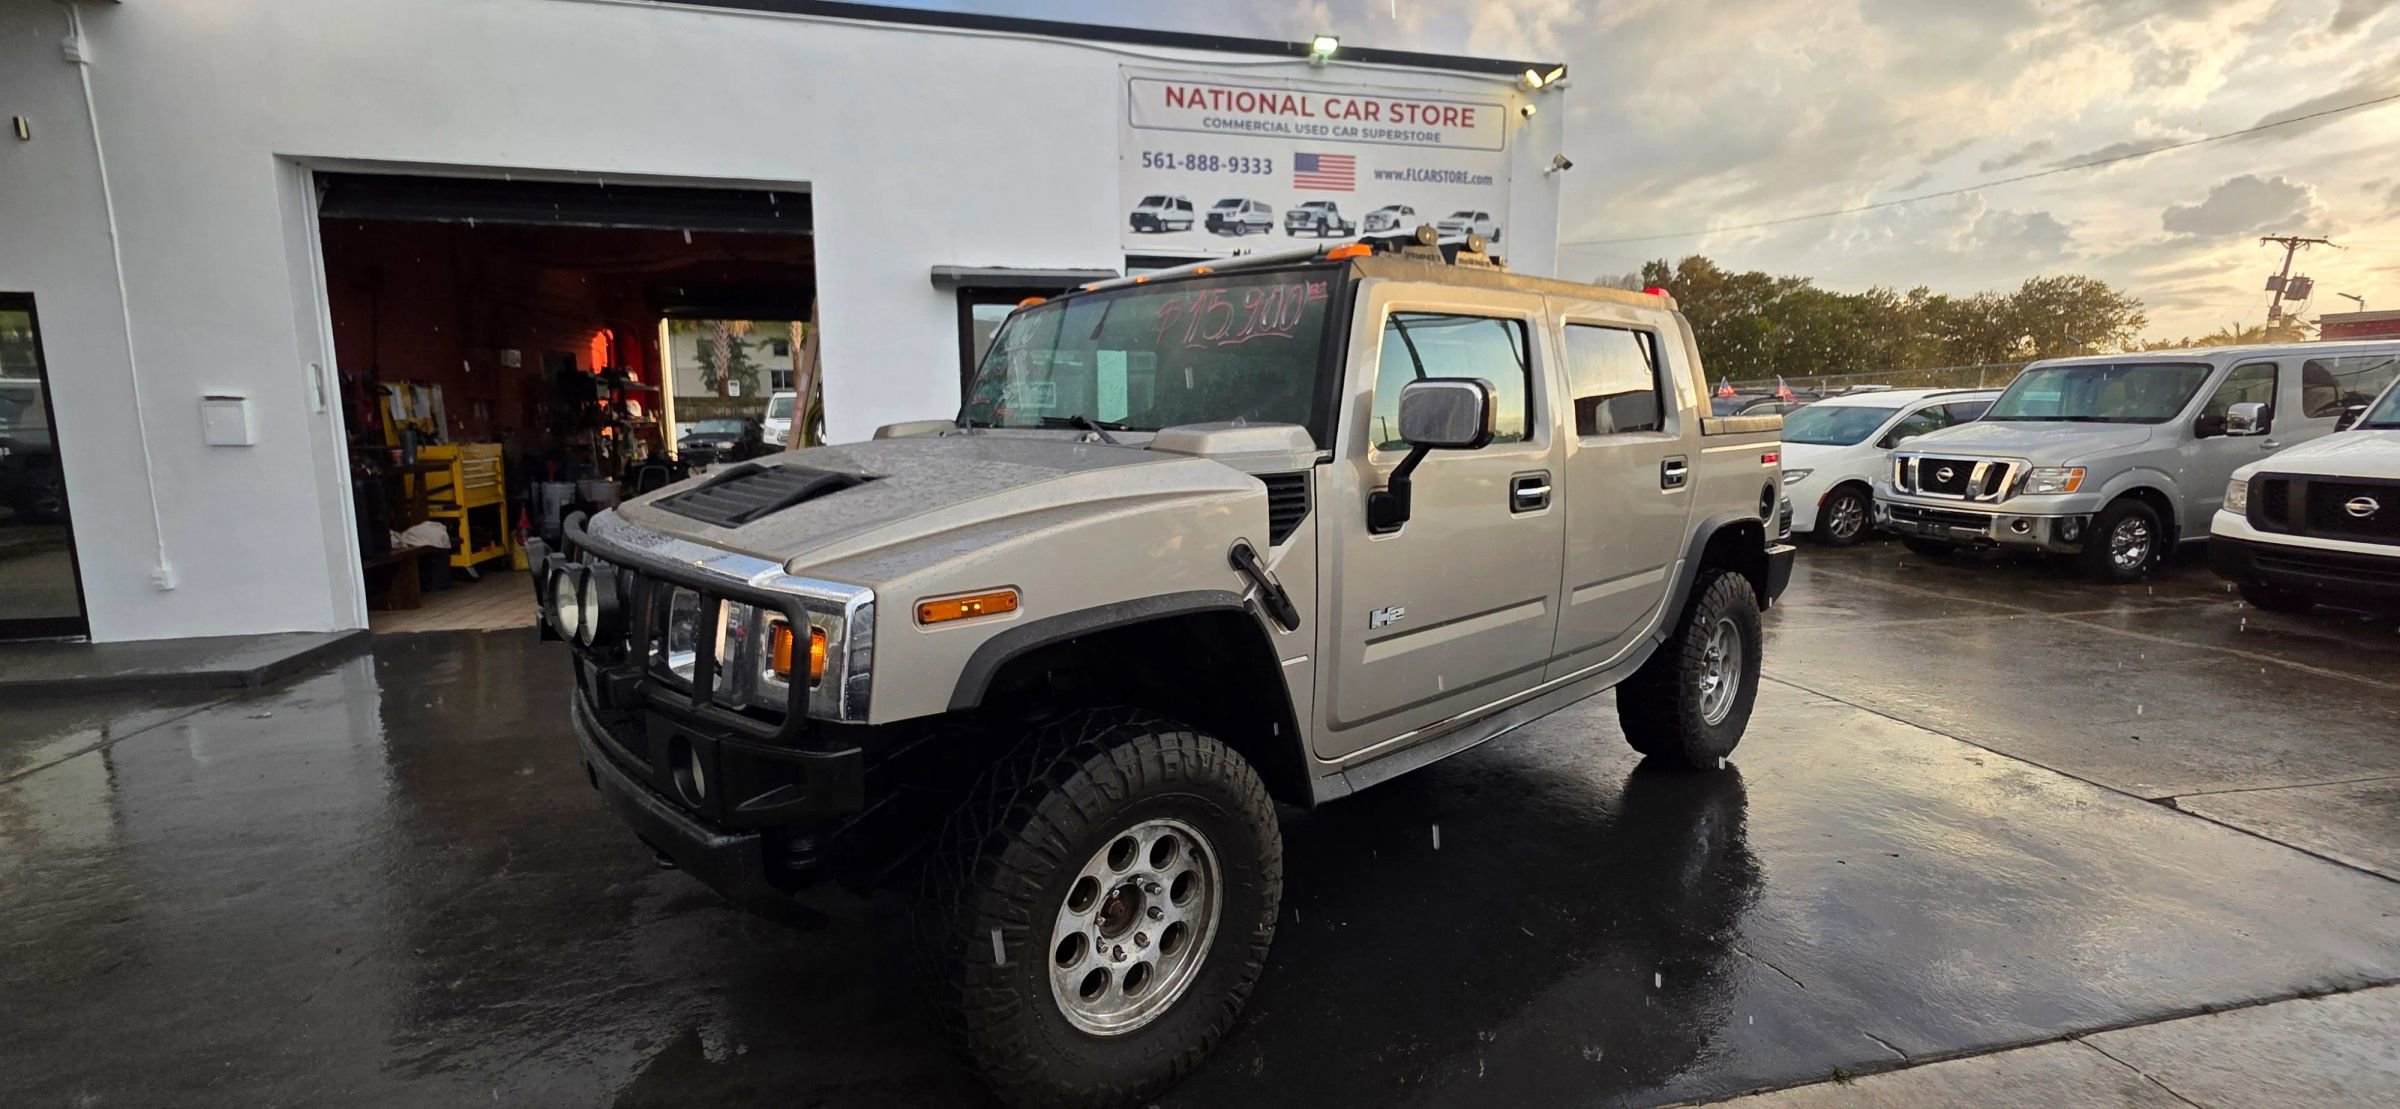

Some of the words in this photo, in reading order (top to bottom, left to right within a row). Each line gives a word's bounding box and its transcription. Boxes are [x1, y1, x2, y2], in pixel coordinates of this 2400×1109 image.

[1165, 86, 1315, 117] NATIONAL
[1324, 98, 1380, 122] CAR
[1389, 103, 1475, 128] STORE
[1202, 117, 1291, 133] COMMERCIAL
[1295, 123, 1329, 136] USED
[1332, 126, 1358, 137] CAR
[1362, 128, 1441, 143] SUPERSTORE
[1142, 151, 1272, 175] 561-888-9333
[1374, 168, 1493, 185] www.FLCARSTORE.com
